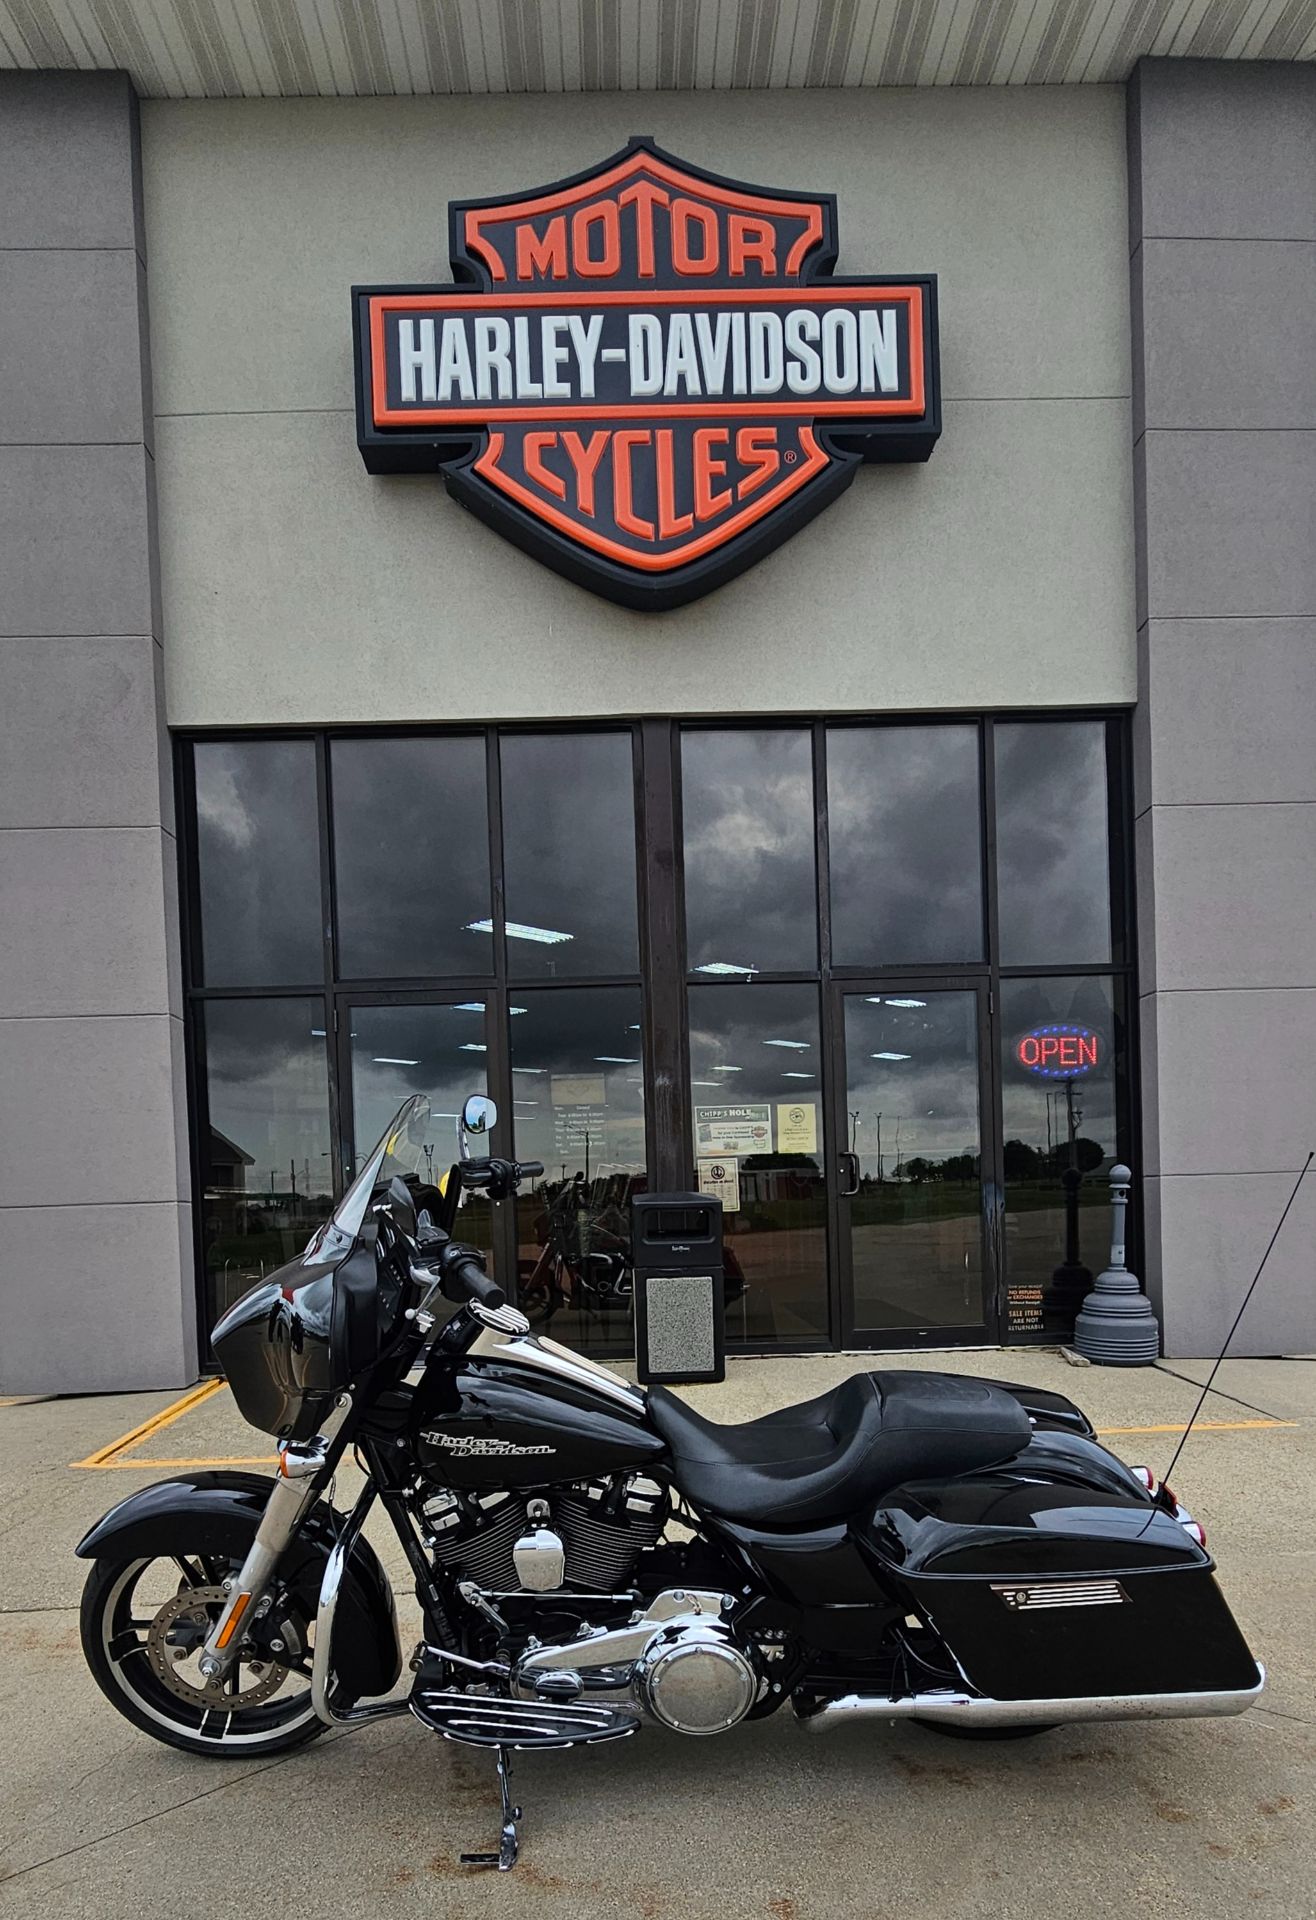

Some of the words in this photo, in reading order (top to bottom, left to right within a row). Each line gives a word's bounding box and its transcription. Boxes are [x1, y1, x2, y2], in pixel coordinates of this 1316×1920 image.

[514, 179, 777, 280] MOTOR
[398, 307, 899, 402] HARLEY-DAVIDSON
[523, 426, 780, 542] CYCLES
[1019, 1036, 1097, 1065] OPEN
